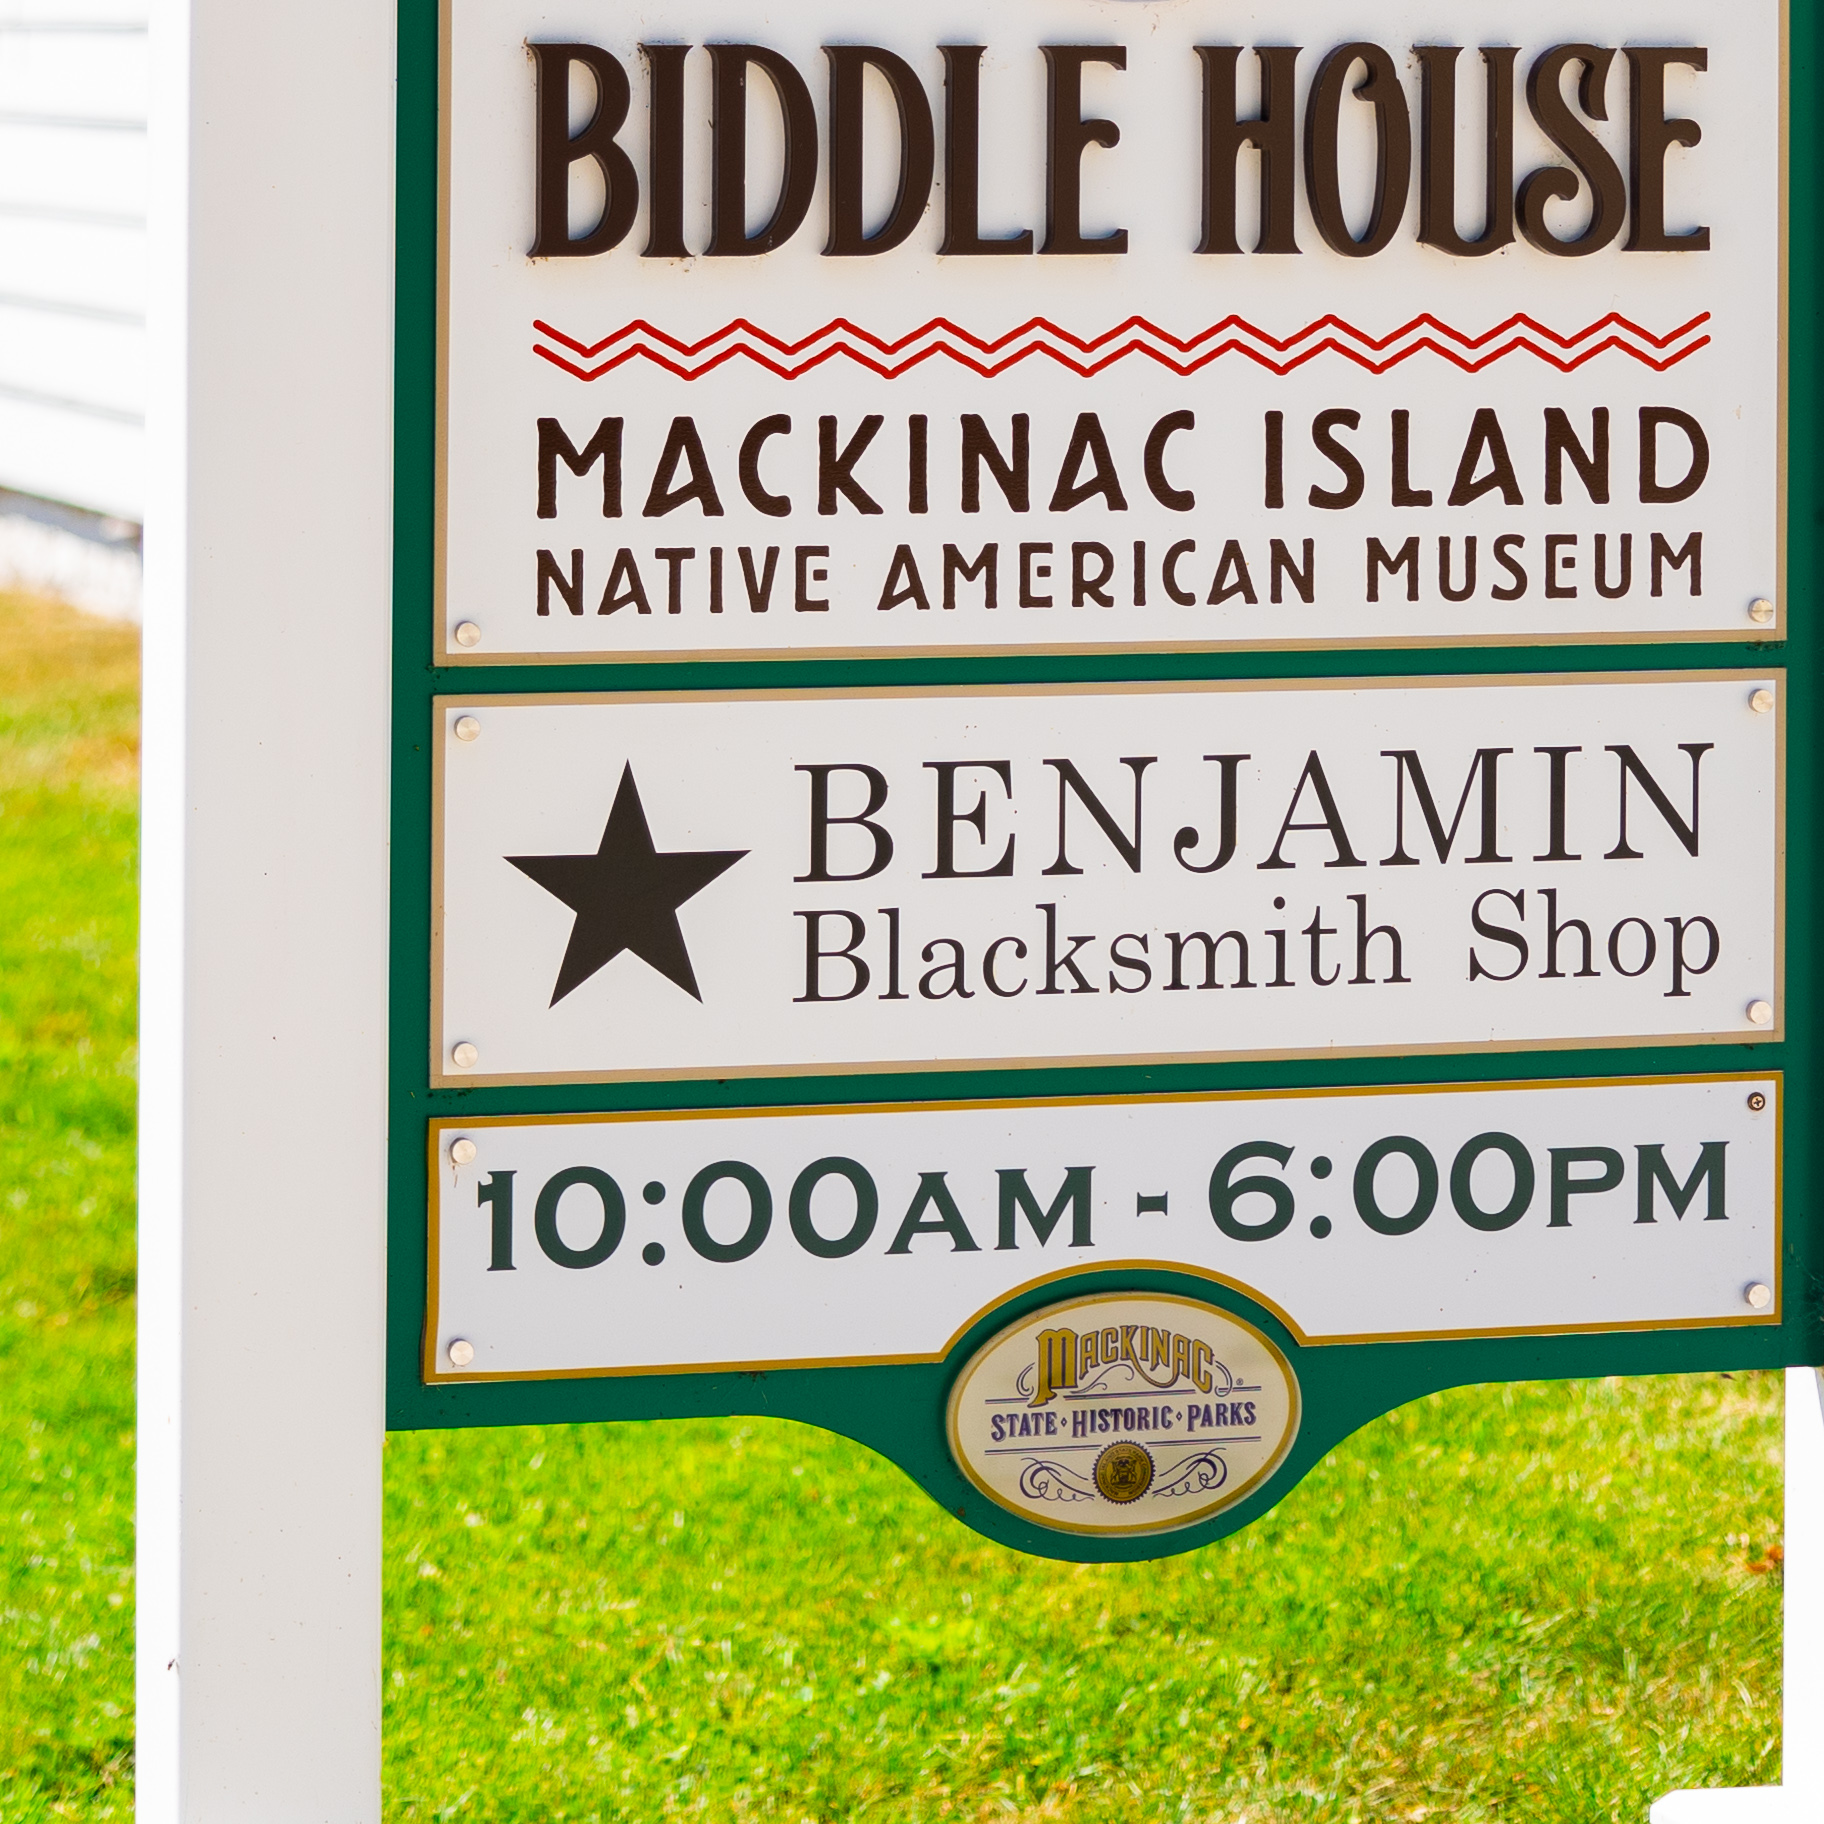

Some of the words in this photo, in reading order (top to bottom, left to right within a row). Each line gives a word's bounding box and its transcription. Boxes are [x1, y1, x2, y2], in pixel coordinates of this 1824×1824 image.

[526, 42, 1128, 259] BIDDLE
[1191, 40, 1711, 257] HOUSE
[536, 409, 1195, 519] MACKINAC
[1264, 406, 1710, 509] ISLAND
[536, 545, 830, 616] NATIVE
[876, 537, 1315, 611] AMERICAN
[1366, 531, 1703, 603] MUSEUM
[793, 742, 1715, 883] BENJAMIN
[792, 893, 1412, 1003] Blacksmith
[1469, 887, 1720, 998] Shop
[477, 1156, 1096, 1271] 10:00AM
[1208, 1131, 1730, 1242] 6:00PM
[991, 1412, 1058, 1442] STATE
[1071, 1405, 1173, 1438] HISTORIC
[1187, 1401, 1257, 1433] PARKS
[1027, 1325, 1214, 1407] MACKINAC
